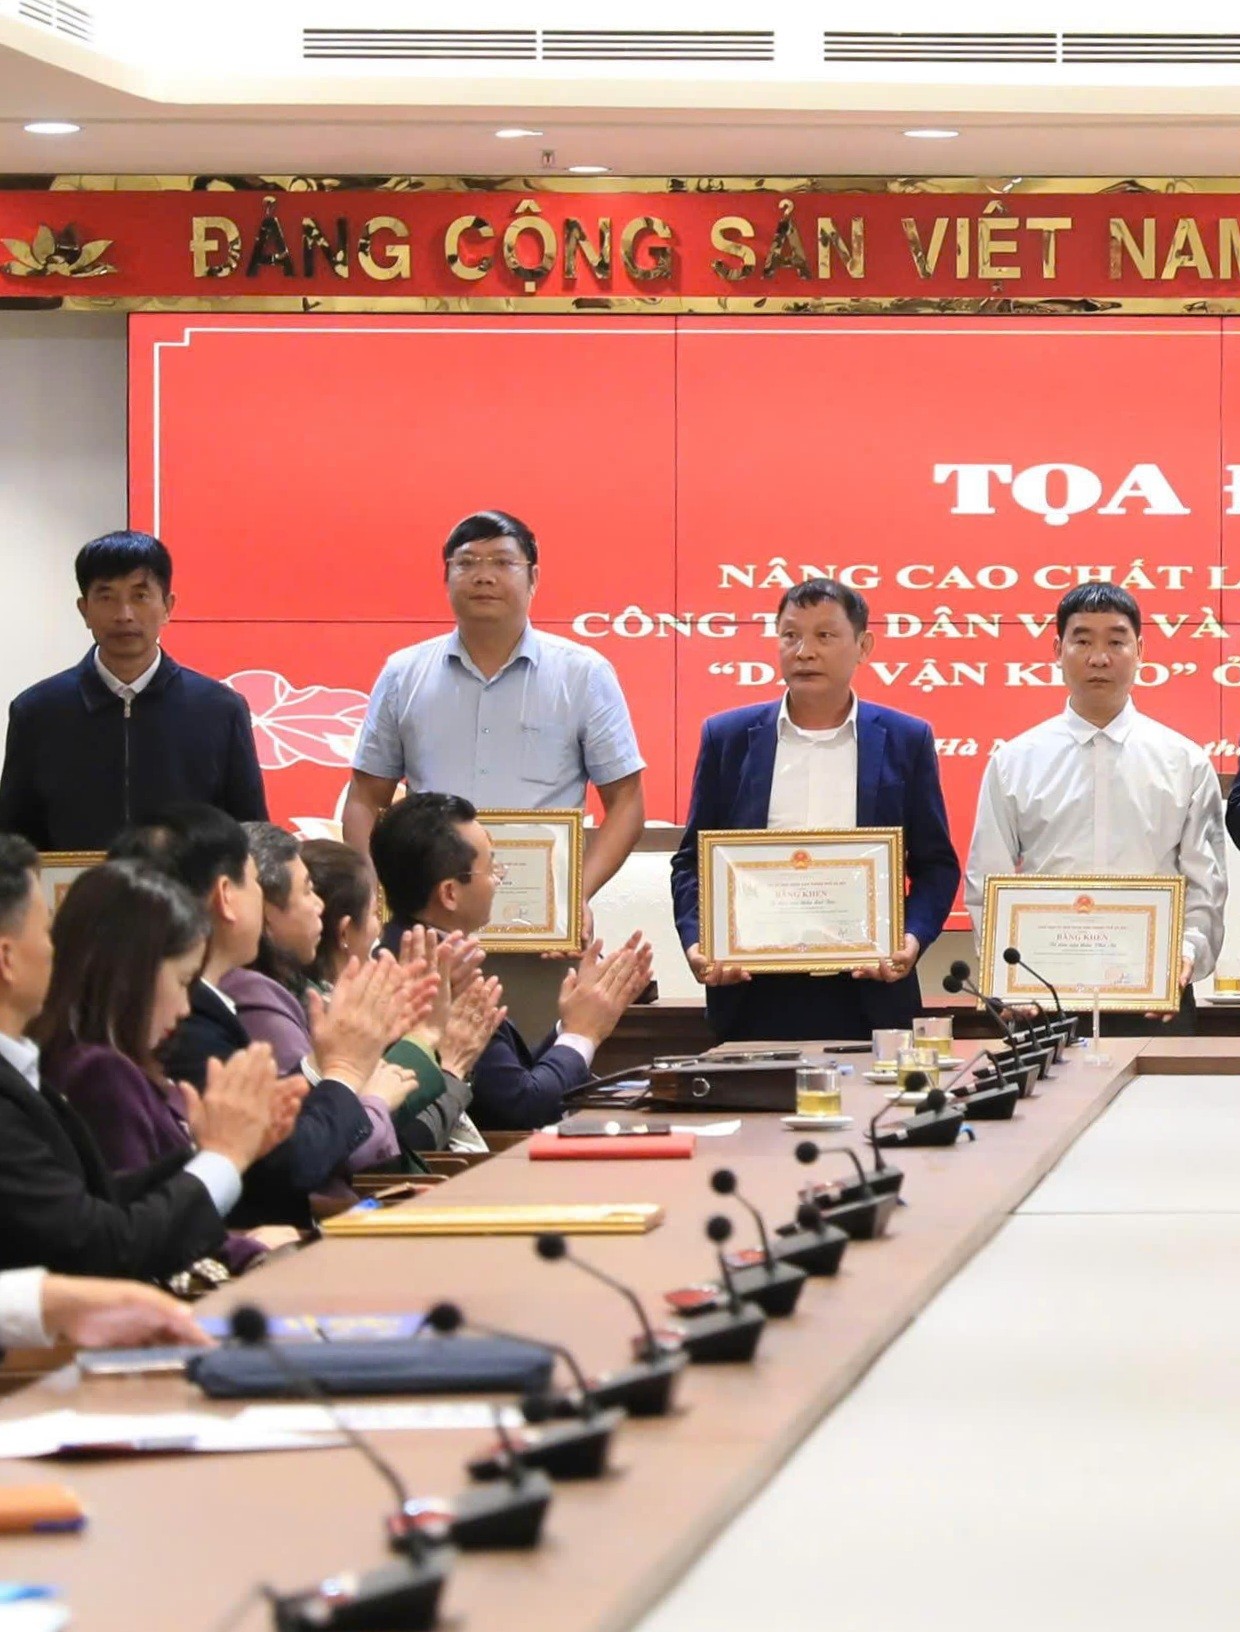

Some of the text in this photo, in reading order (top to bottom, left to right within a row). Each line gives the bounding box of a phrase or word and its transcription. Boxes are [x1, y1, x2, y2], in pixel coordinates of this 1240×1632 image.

[190, 196, 411, 281] ĐẢNG
[444, 198, 673, 292] CỘNG
[710, 199, 865, 282] SẢN
[901, 200, 1072, 292] VIỆT
[934, 463, 1190, 526] TỌA
[895, 564, 1018, 589] CAO
[1033, 558, 1193, 590] CHẤT
[572, 605, 738, 637] CÔNG
[884, 605, 1003, 638] DÂN
[1150, 607, 1230, 638] VÀ
[870, 658, 988, 692] VẬN
